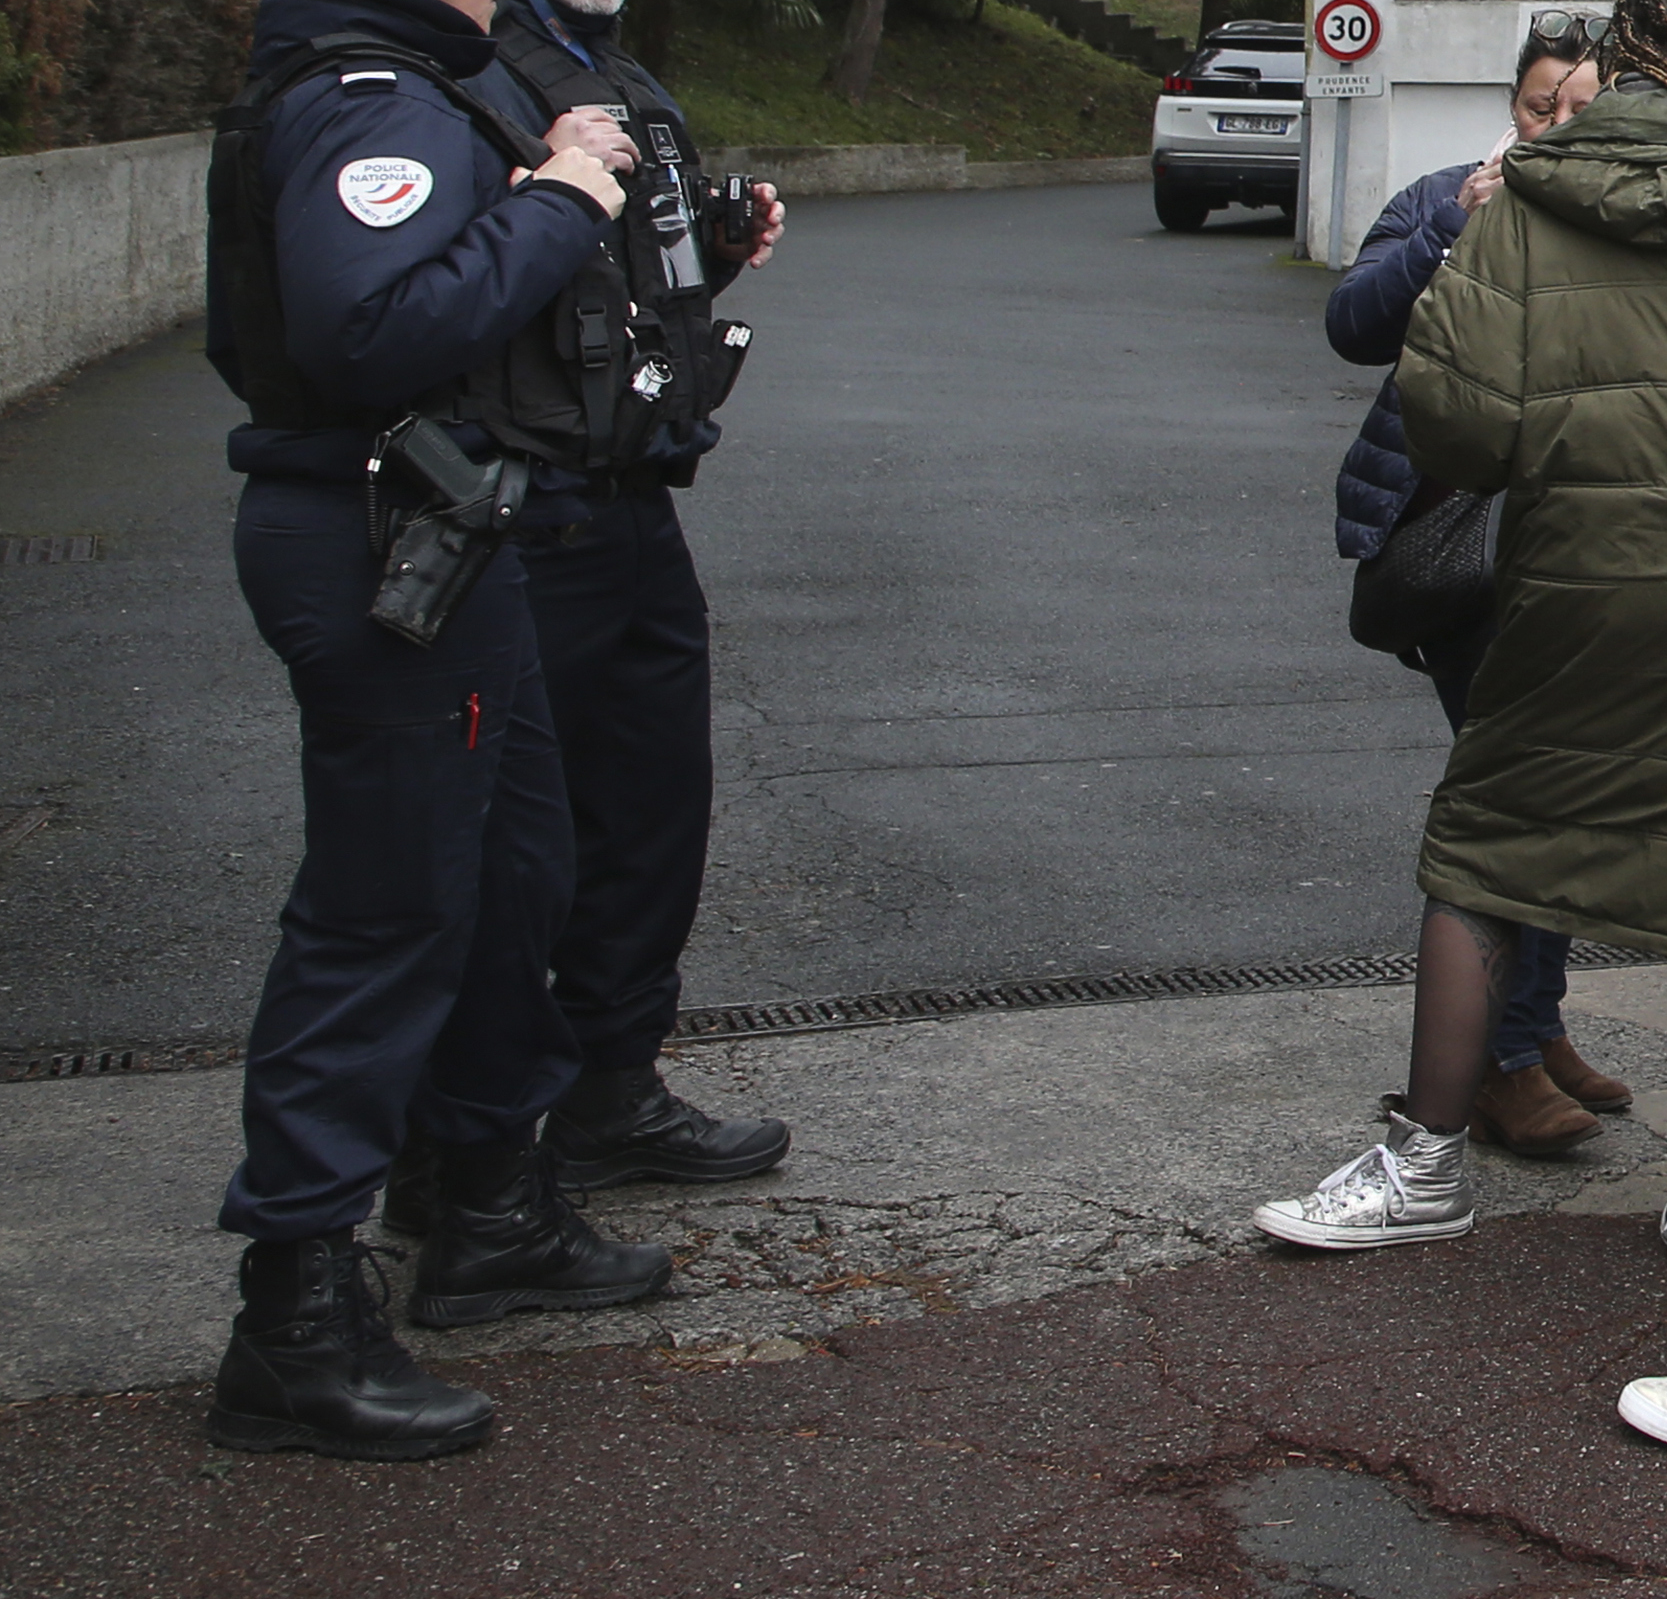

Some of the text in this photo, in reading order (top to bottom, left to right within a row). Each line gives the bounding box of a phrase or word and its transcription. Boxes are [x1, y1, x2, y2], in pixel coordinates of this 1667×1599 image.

[1328, 15, 1366, 42] 30
[1318, 76, 1370, 85] PRUDENCE
[1322, 86, 1366, 95] ENFANTS
[364, 164, 407, 173] POLICE
[349, 173, 422, 183] NATIONALE
